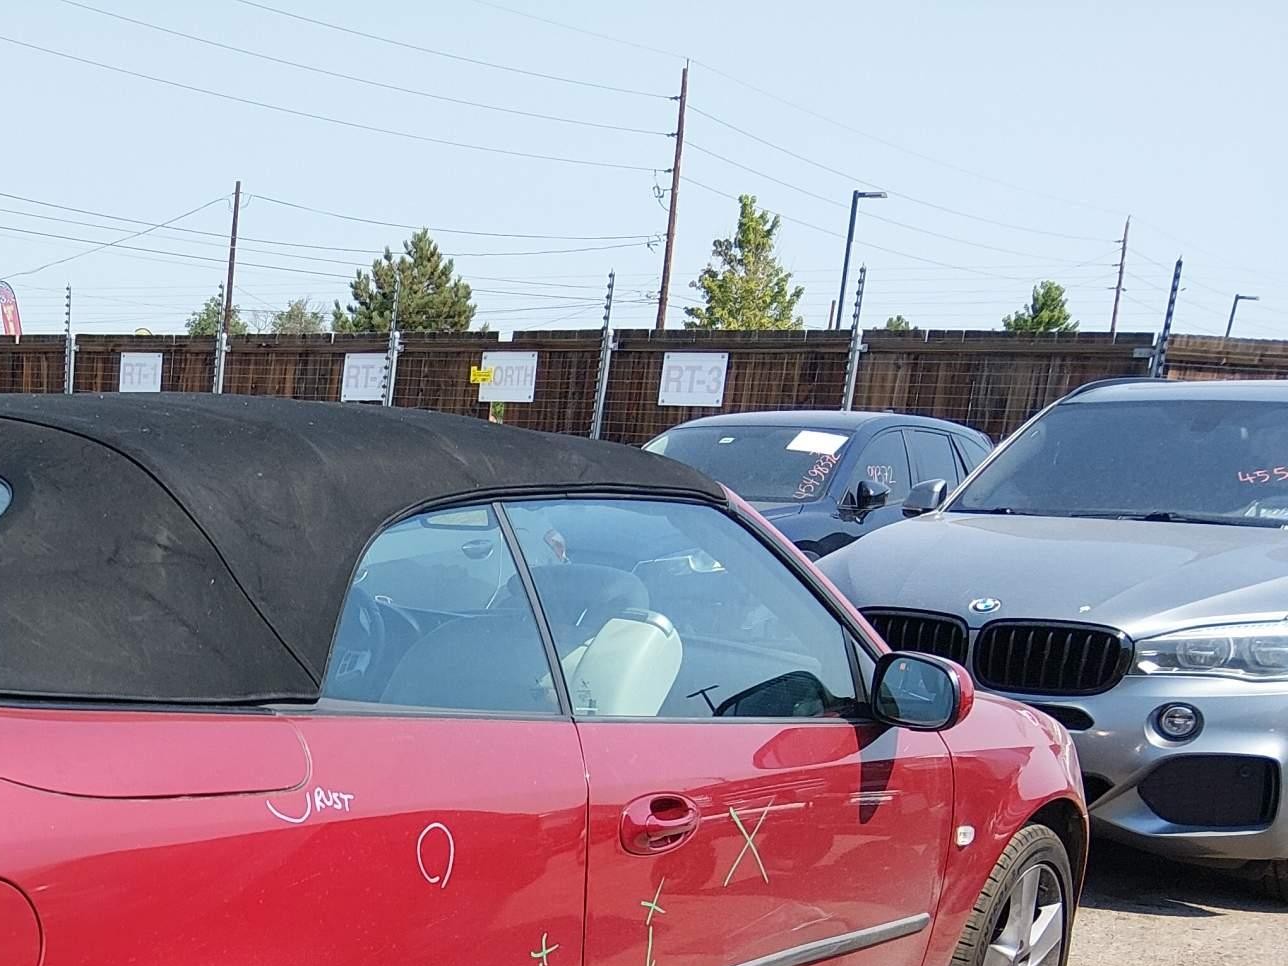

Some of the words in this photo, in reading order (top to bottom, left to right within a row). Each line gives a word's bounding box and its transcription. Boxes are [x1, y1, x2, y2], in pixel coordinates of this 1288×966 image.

[122, 362, 159, 386] RT-1
[483, 365, 535, 387] ORTH
[663, 364, 722, 394] RT-3
[314, 787, 354, 812] RUST
